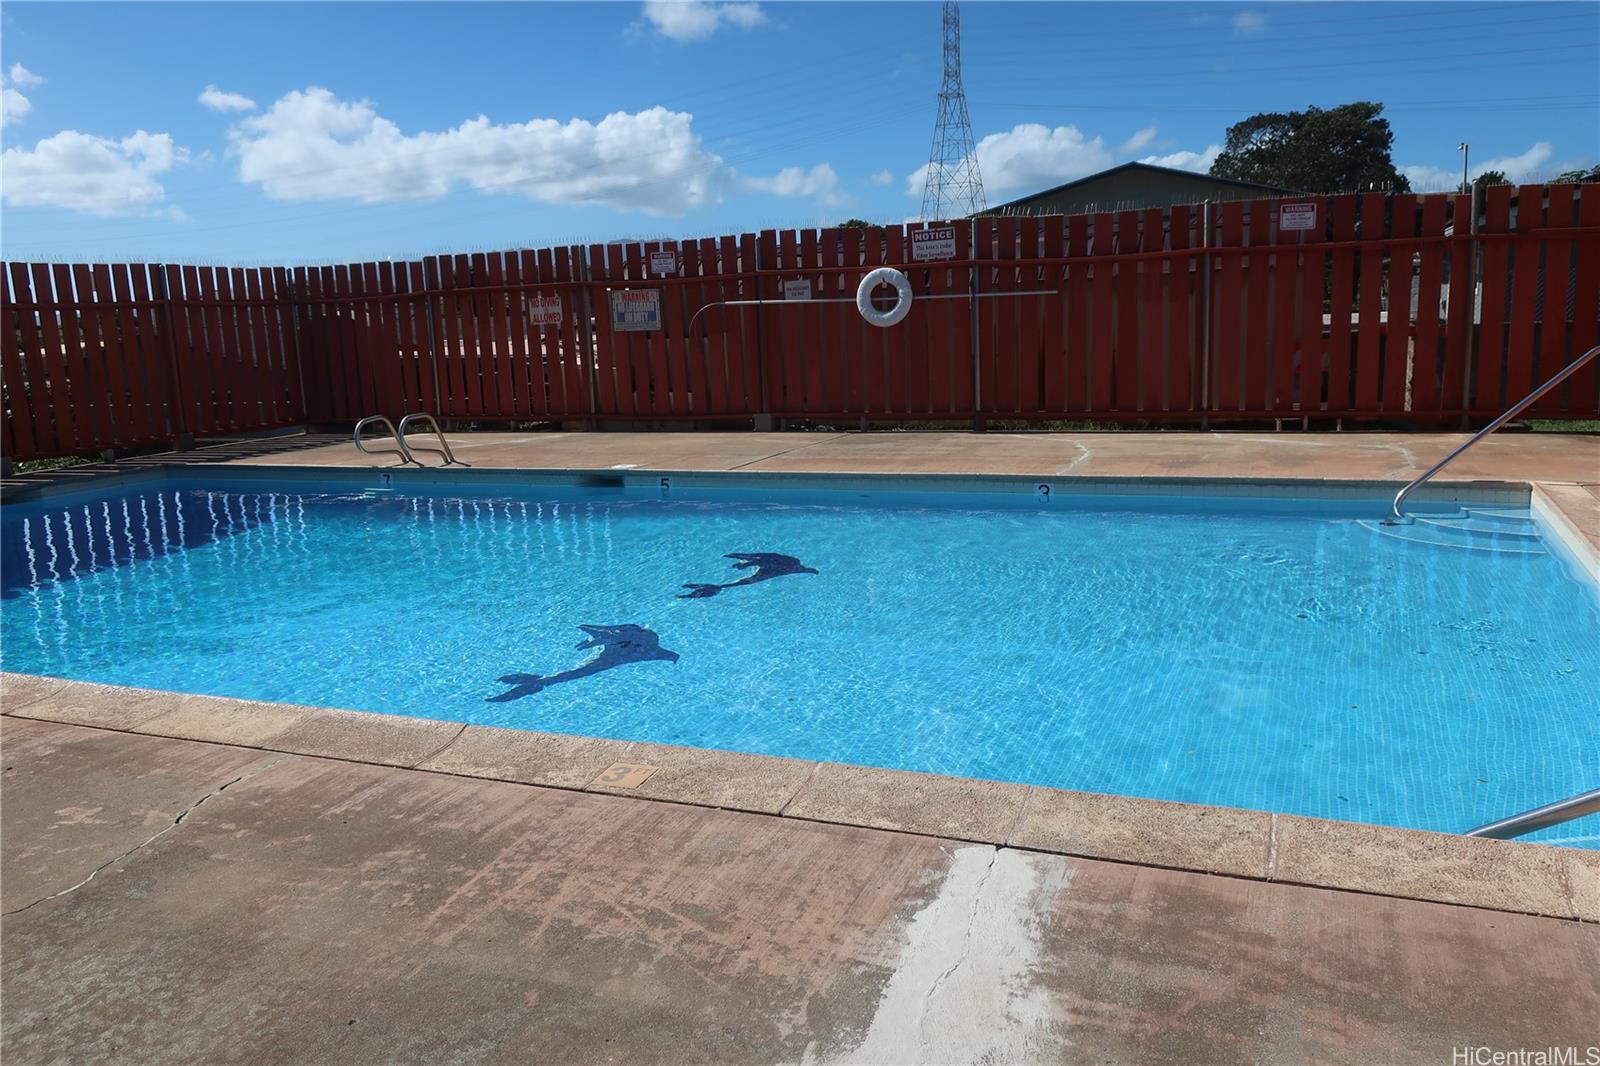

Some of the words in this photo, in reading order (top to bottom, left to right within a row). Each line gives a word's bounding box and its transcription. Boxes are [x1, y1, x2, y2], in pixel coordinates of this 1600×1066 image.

[914, 231, 953, 241] NOTICE
[531, 298, 540, 308] NO
[541, 297, 559, 307] DIVING
[622, 292, 650, 302] WARNING
[625, 301, 655, 312] LIFEGUARD
[532, 312, 560, 322] ALLOWED
[624, 312, 633, 322] ON
[634, 311, 649, 321] DUTY
[382, 474, 390, 485] 7
[1038, 484, 1050, 496] 3
[601, 767, 632, 782] 3
